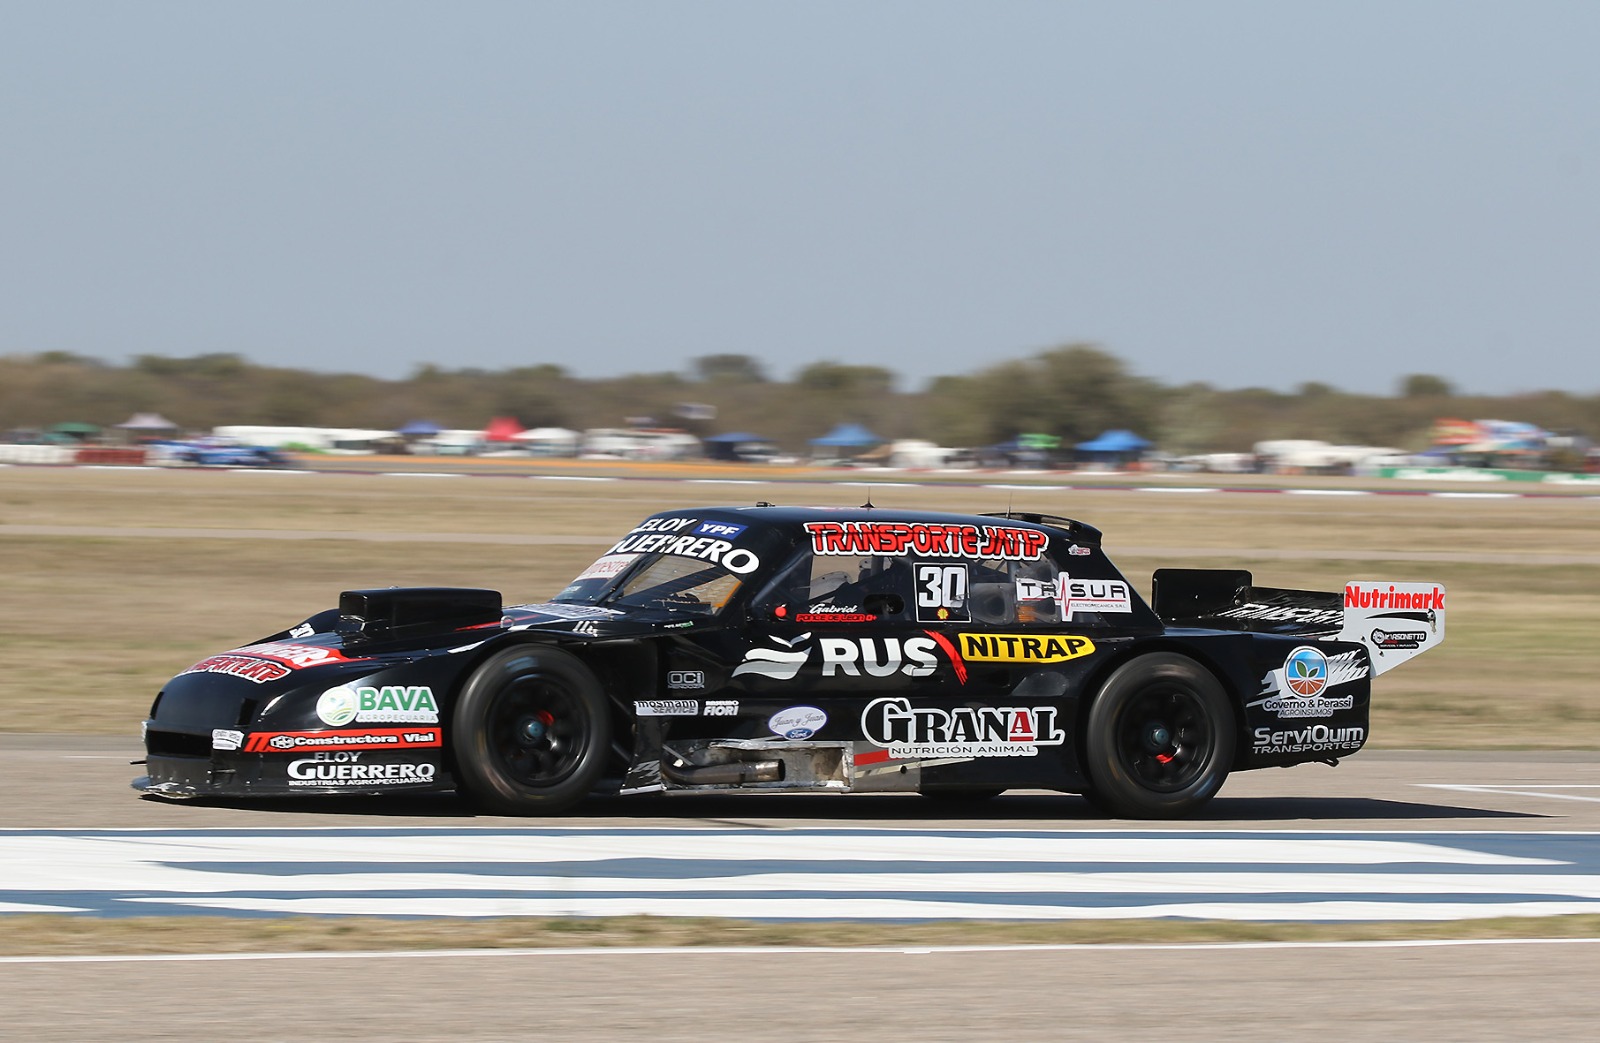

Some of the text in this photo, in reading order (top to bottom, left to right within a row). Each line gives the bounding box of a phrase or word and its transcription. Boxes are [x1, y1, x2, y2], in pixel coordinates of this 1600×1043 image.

[700, 523, 740, 536] YPF
[805, 522, 1047, 558] TRANSPORTE JATIP
[918, 565, 966, 608] 30
[1344, 585, 1445, 610] Nutrimark
[809, 603, 858, 614] Gabriel
[966, 636, 1086, 660] NITRAP
[819, 637, 938, 677] RUS
[359, 689, 436, 712] BAVA
[1264, 697, 1352, 710] Governo & Perassi
[652, 706, 696, 714] SERVICE
[1279, 708, 1333, 717] AGROINSUMOS
[359, 714, 436, 722] AGROPECUARIA
[864, 699, 1061, 744] GRANAL
[294, 732, 434, 746] Constructora Vial
[1253, 724, 1364, 746] ServiQuim
[891, 744, 1034, 755] NUTRICIÓN ANIMAL
[1252, 740, 1361, 754] TRANSPORTES
[314, 751, 362, 762] ELOY
[286, 759, 436, 780] GUERRERO
[346, 777, 434, 786] AGROPECUARIAS
